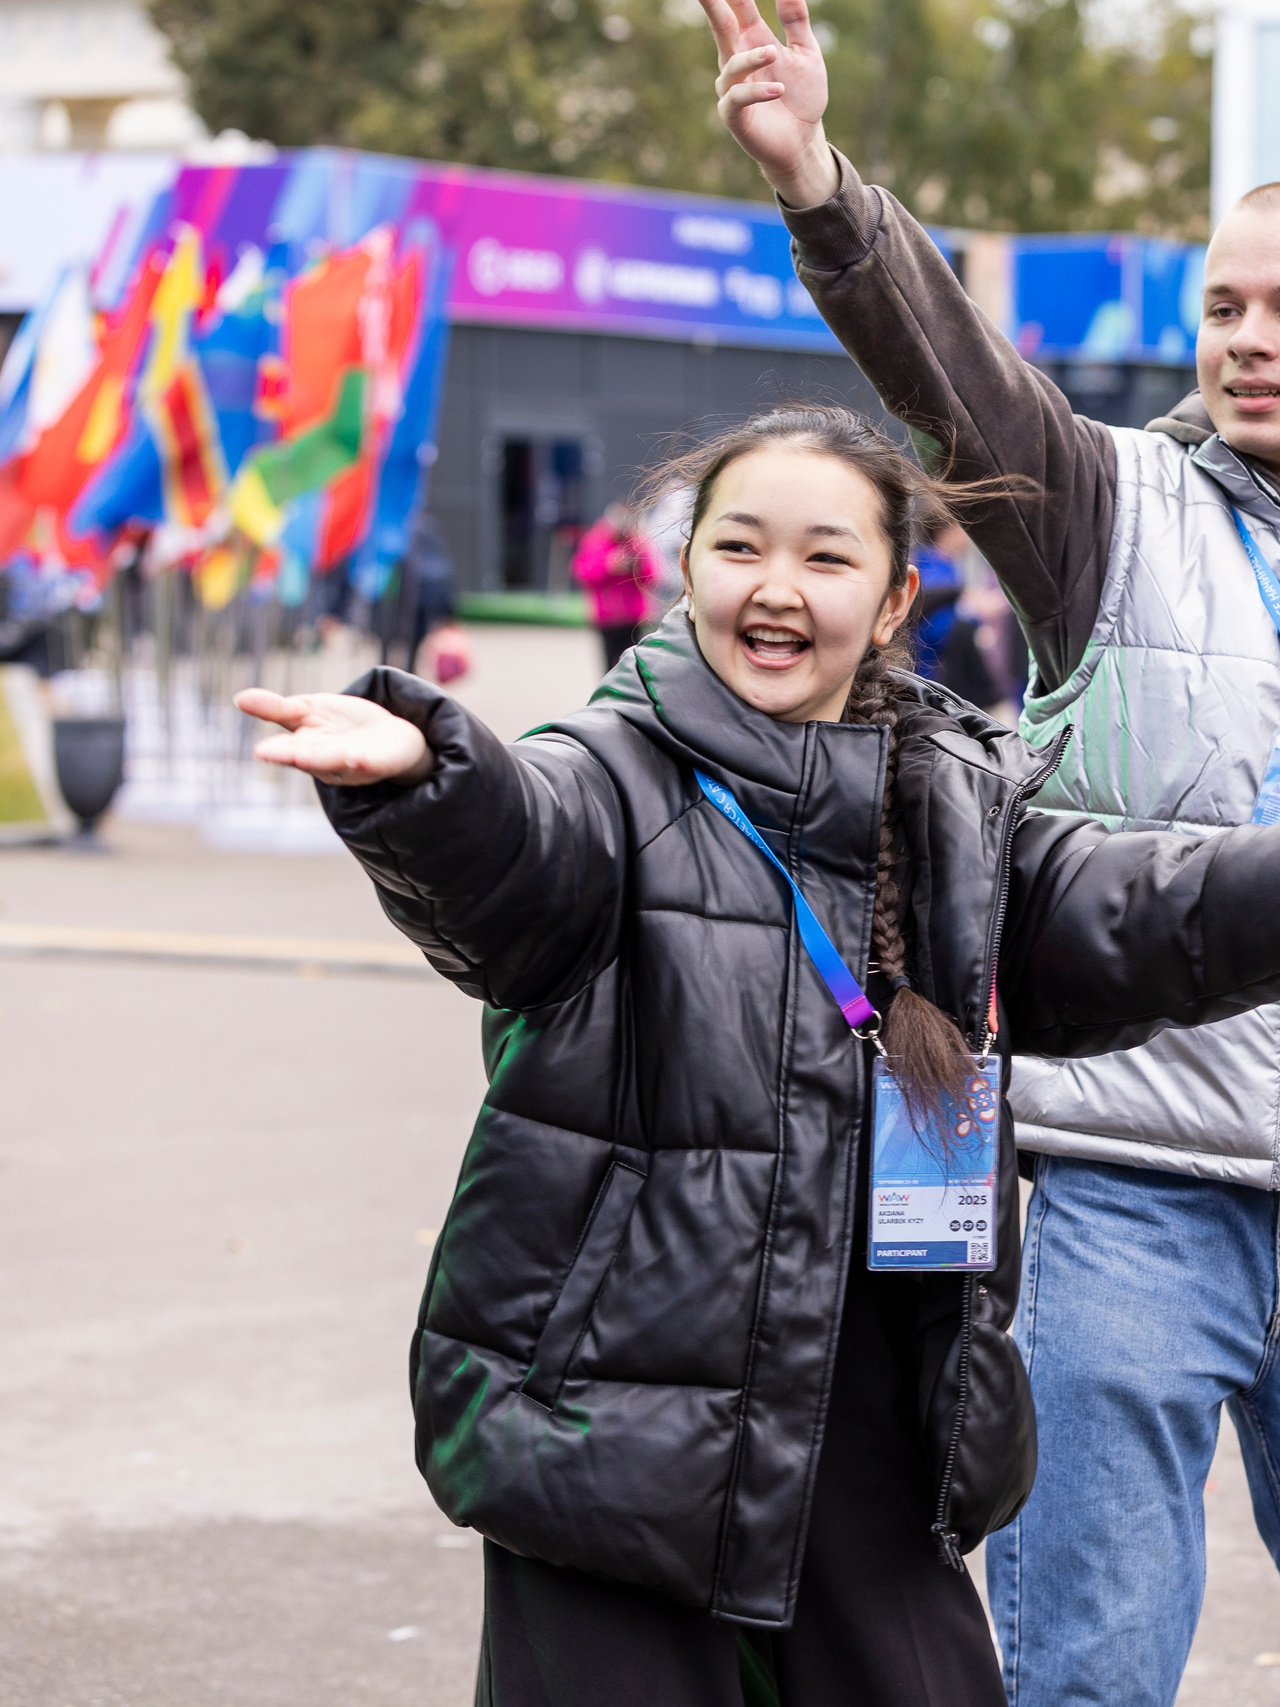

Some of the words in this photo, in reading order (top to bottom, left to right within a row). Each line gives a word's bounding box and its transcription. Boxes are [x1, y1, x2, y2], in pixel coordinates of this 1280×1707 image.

[879, 1192, 910, 1202] WAW
[958, 1195, 987, 1205] 2025
[876, 1249, 928, 1257] PARTICIPANT
